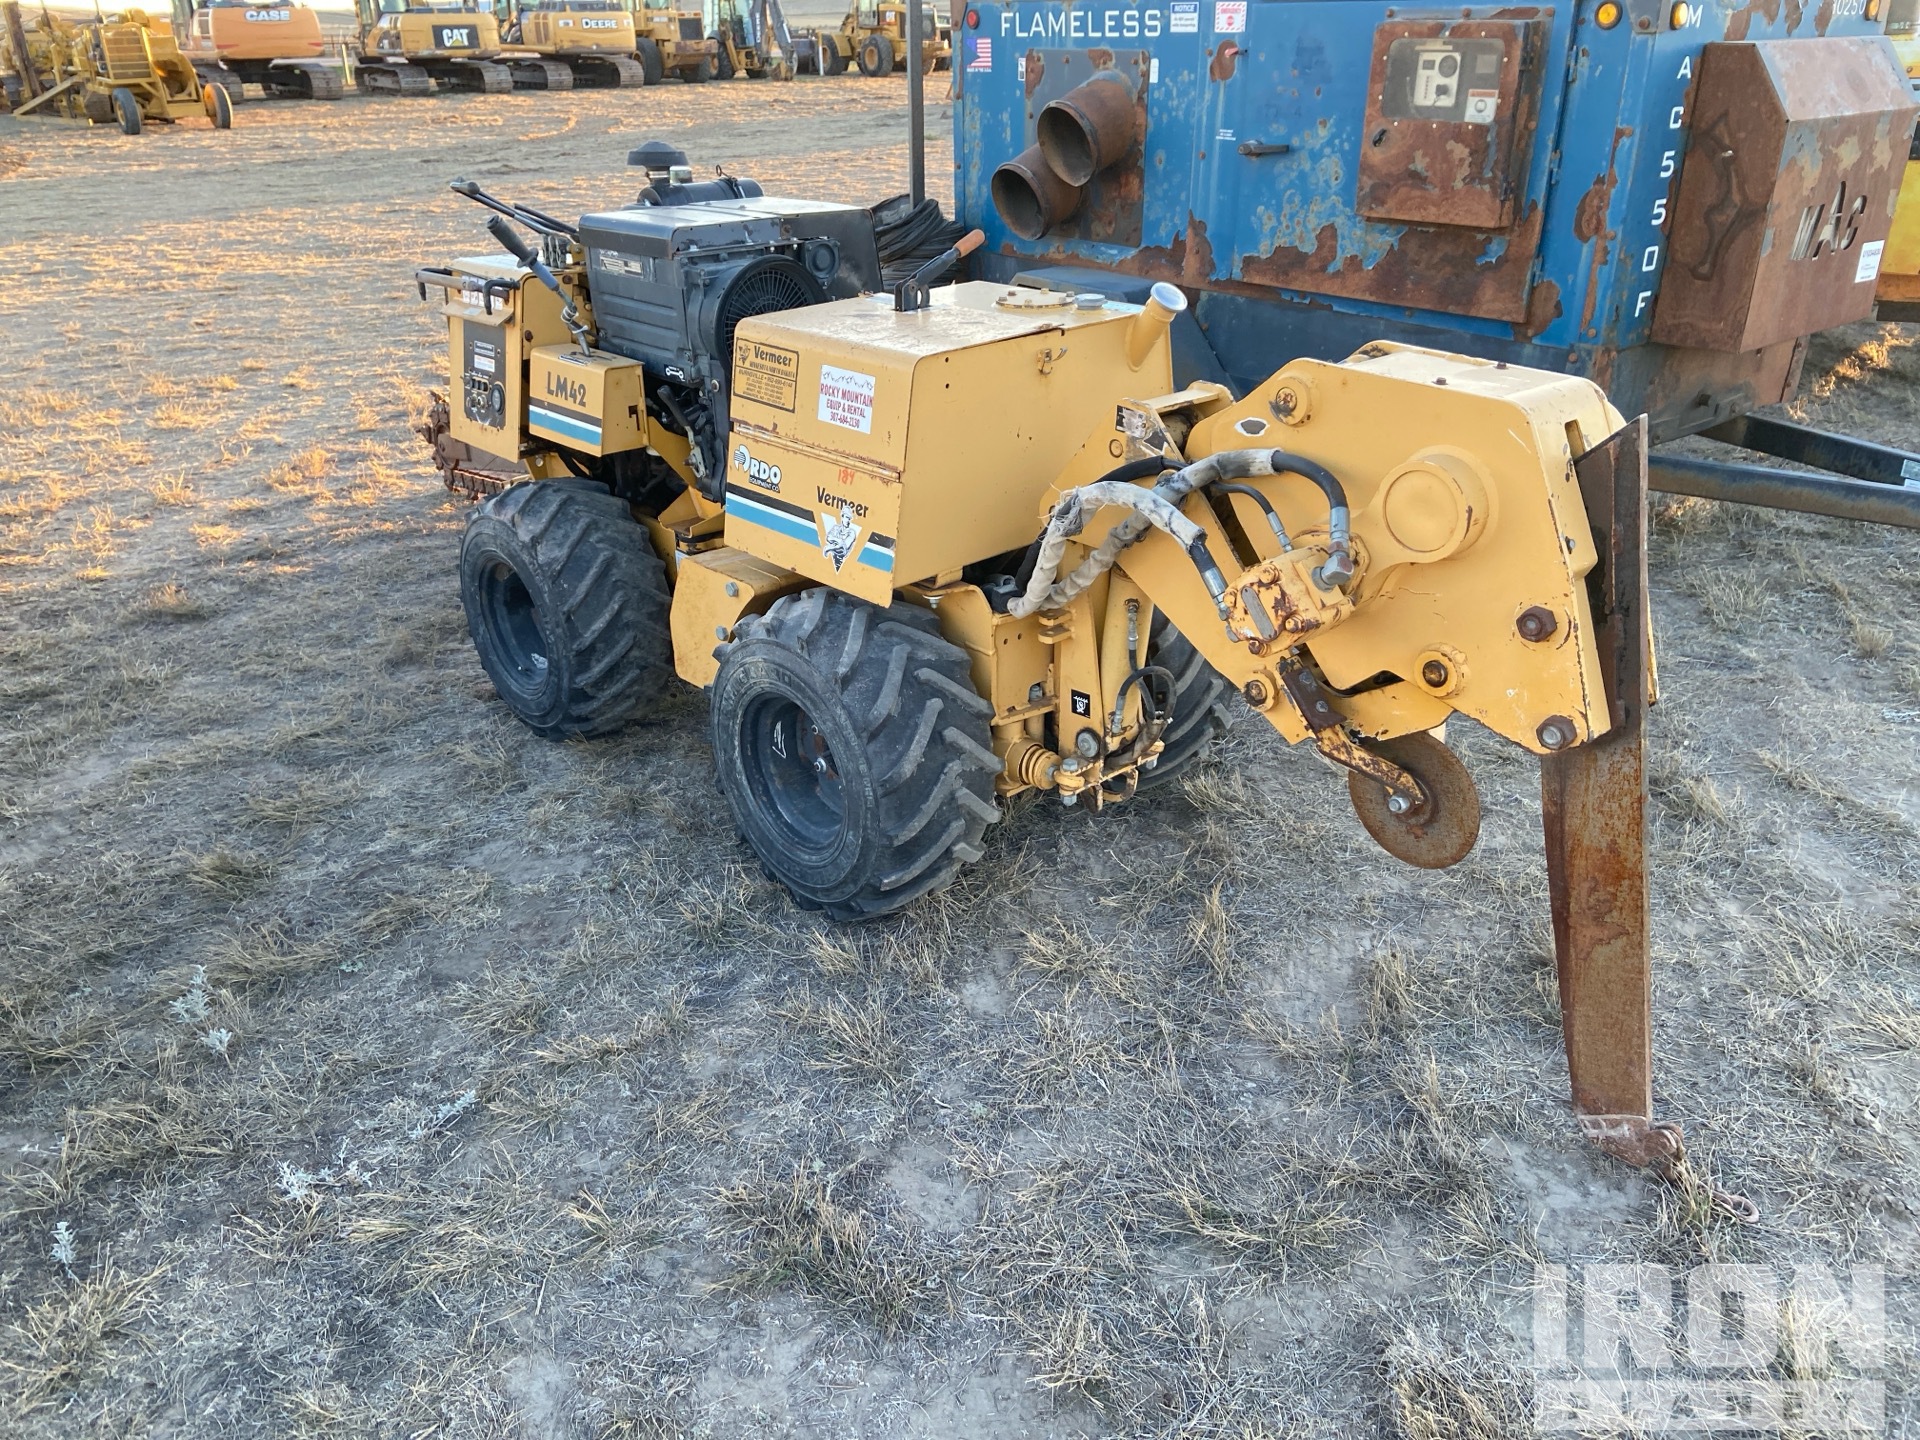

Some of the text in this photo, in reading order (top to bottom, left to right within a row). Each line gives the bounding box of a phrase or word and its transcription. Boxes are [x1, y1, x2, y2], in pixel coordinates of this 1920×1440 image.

[245, 10, 290, 21] CASE
[581, 18, 618, 29] DEERE
[1001, 10, 1161, 37] FLAMELESS
[442, 28, 469, 47] CAT
[754, 345, 792, 367] Vermeer
[547, 371, 586, 408] LM42
[820, 383, 873, 407] ROCKY MOUNTAIN
[826, 398, 841, 411] EQUIP
[847, 403, 866, 418] RENTAL
[749, 457, 782, 485] RDO
[817, 486, 869, 518] Vermeer
